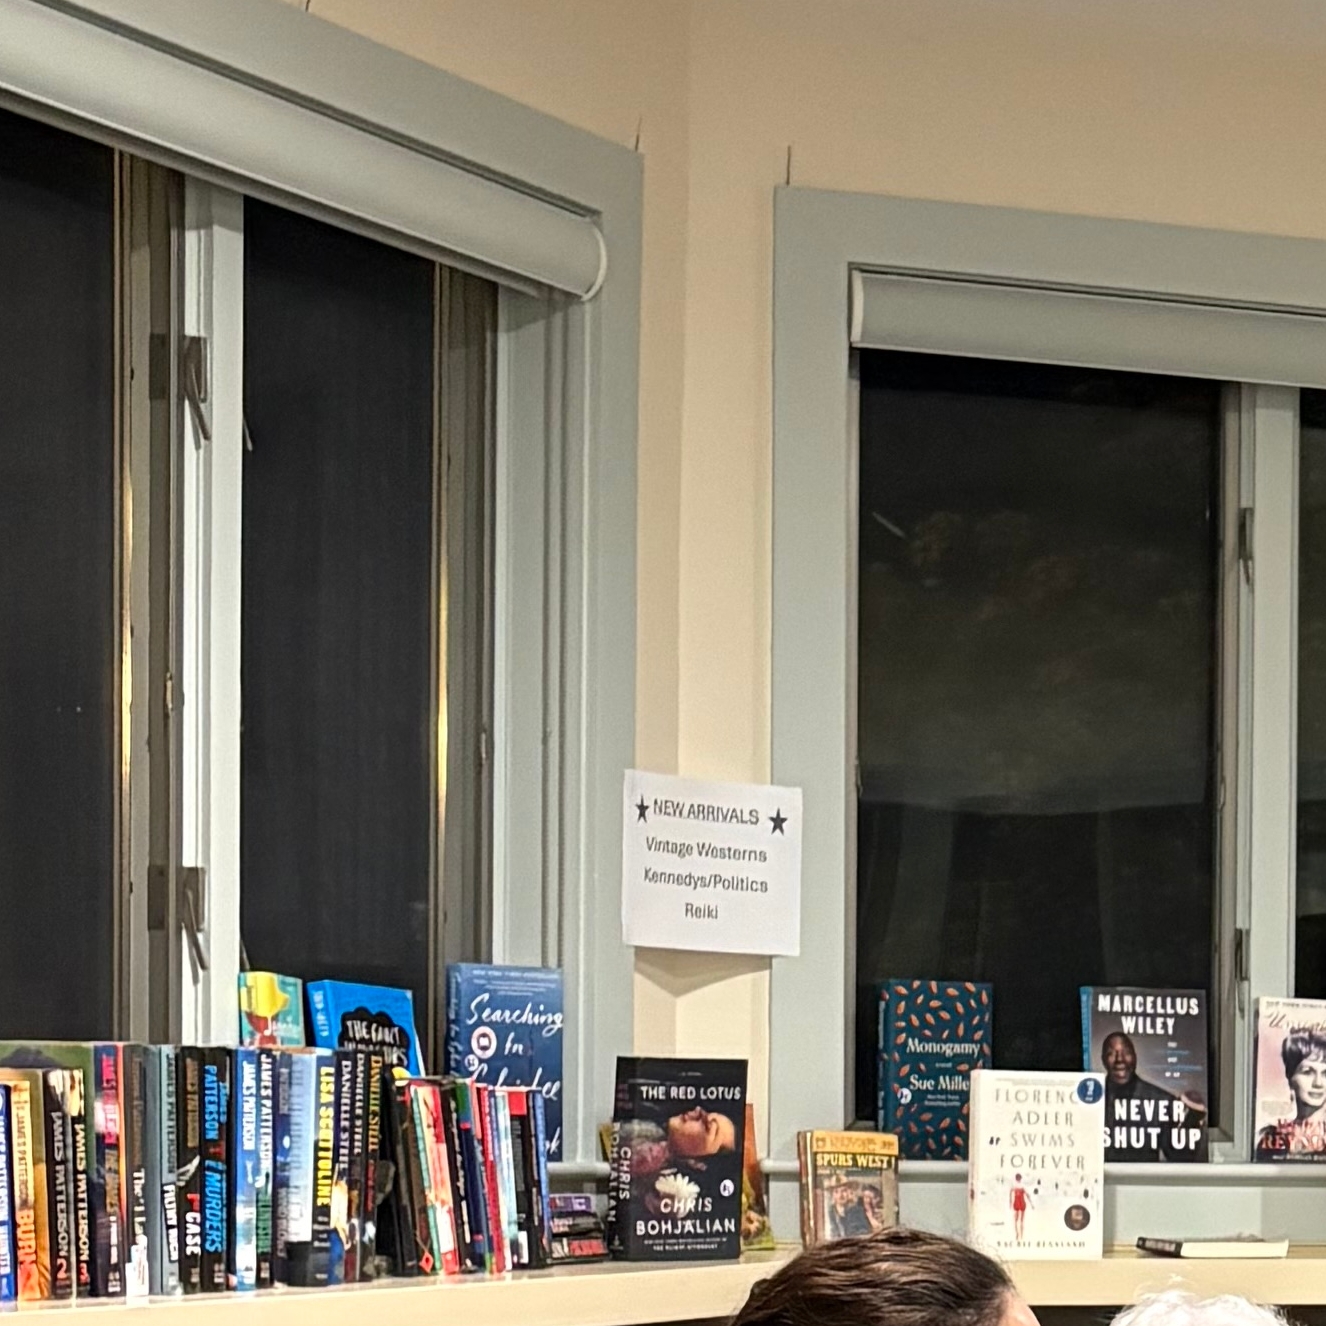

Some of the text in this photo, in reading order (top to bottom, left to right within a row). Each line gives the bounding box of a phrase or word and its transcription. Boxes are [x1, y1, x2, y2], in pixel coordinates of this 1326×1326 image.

[653, 798, 759, 825] NEW ARRIVALS
[646, 836, 767, 862] Vintage Westerns
[644, 867, 768, 893] Kennedys/Politics
[685, 903, 718, 919] Reiki
[1098, 994, 1199, 1015] MARCELLUS
[1121, 1016, 1175, 1035] WILEY
[906, 1037, 980, 1058] Monogamy
[320, 1066, 335, 1103] LISA
[640, 1085, 742, 1100] THE RED LOTUS
[910, 1075, 935, 1092] Sue
[1012, 1111, 1074, 1126] ADLER
[1114, 1099, 1185, 1122] NEVER
[1010, 1132, 1075, 1147] SWIMS
[1171, 1128, 1201, 1150] UP
[816, 1153, 853, 1168] SPURS
[1000, 1153, 1086, 1171] FOREVER
[50, 1112, 69, 1257] JAMES PATTERSON
[659, 1197, 713, 1213] CHRIS
[635, 1217, 736, 1237] BOHJALIAN
